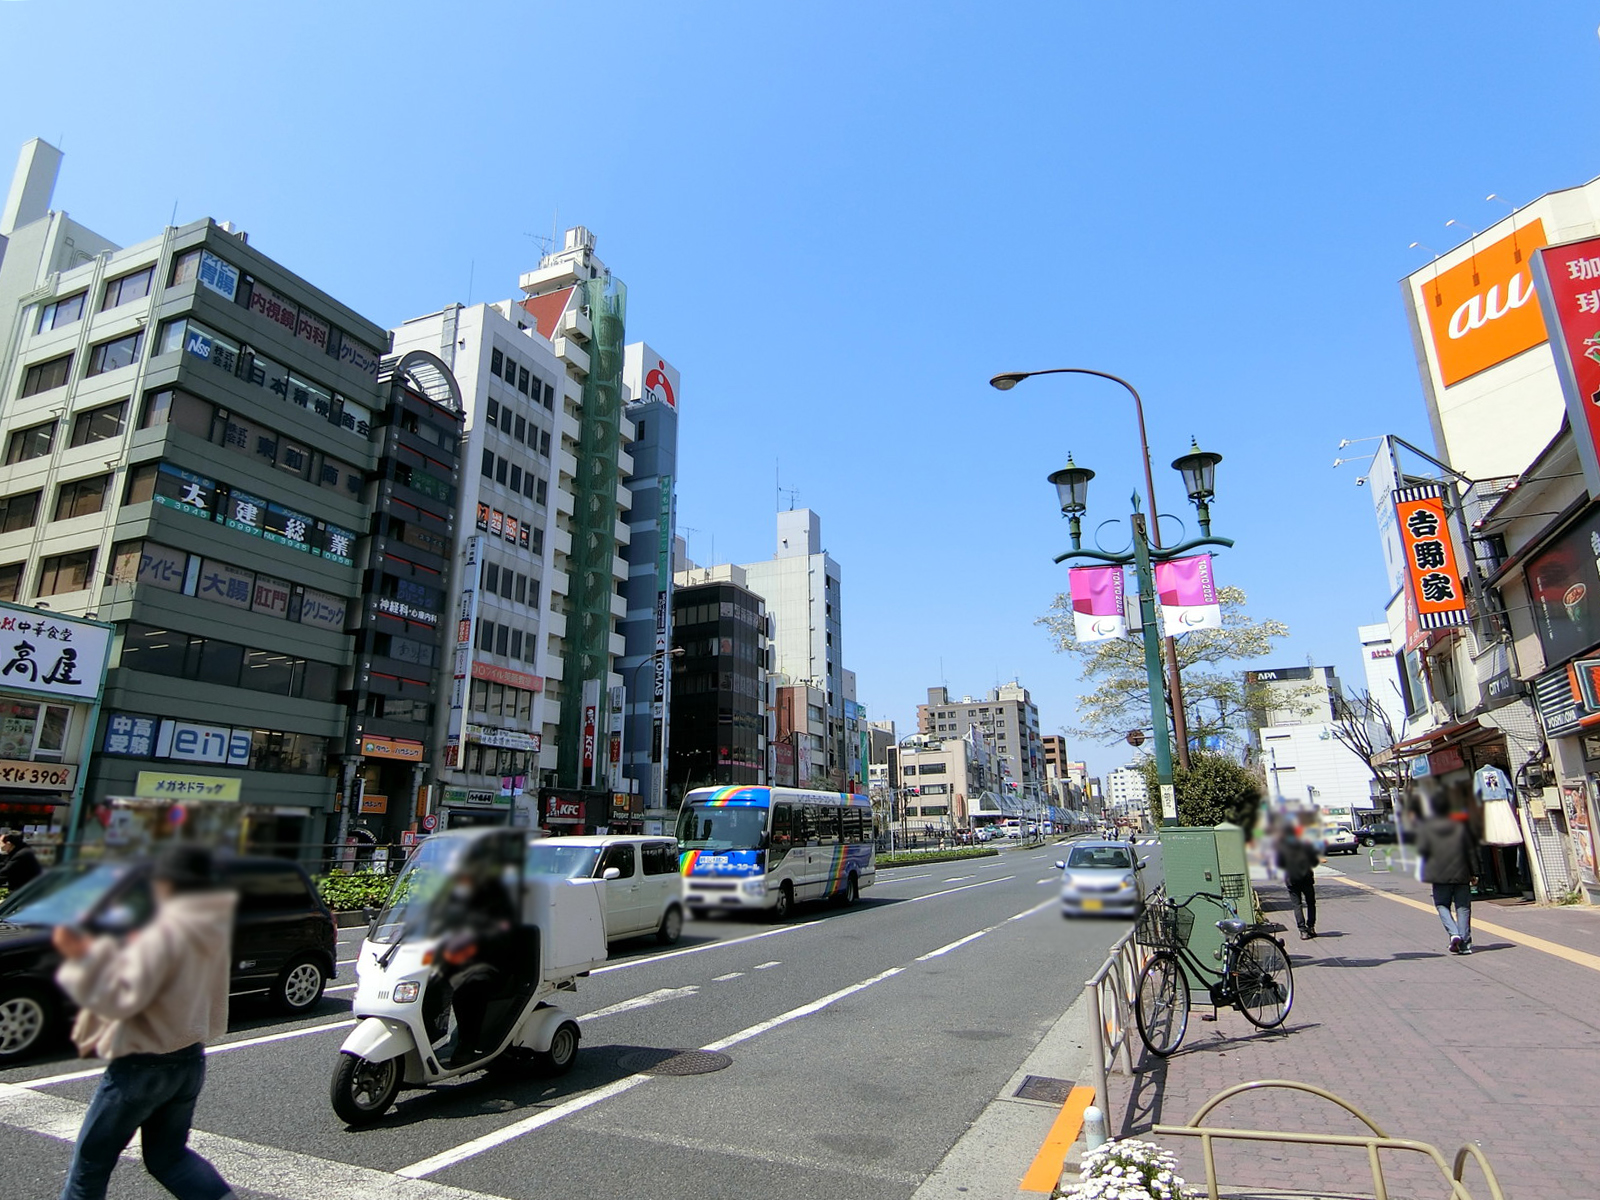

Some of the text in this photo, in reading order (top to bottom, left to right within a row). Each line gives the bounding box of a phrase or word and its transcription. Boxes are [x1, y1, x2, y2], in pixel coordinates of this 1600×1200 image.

[201, 260, 237, 296] 胃腸
[251, 292, 296, 331] 内視鏡
[298, 319, 327, 349] 内科
[341, 343, 377, 375] クリニック
[1448, 272, 1535, 340] au
[263, 531, 276, 541] FAX
[138, 555, 183, 581] アイビー
[1112, 572, 1124, 614] TOKYO 2020
[1198, 560, 1214, 603] TOKYO 2020
[202, 573, 250, 603] 大腸
[254, 585, 289, 612] 肛門
[303, 598, 345, 626] クリニック
[0, 616, 73, 643] 烈中華食堂
[1257, 671, 1277, 680] APA
[112, 717, 154, 737] 中高
[108, 735, 150, 756] 受験
[175, 729, 250, 759] ena
[584, 735, 593, 760] KFC
[0, 767, 29, 783] そば
[155, 780, 226, 794] メガネドラッグ
[560, 804, 579, 815] KFC
